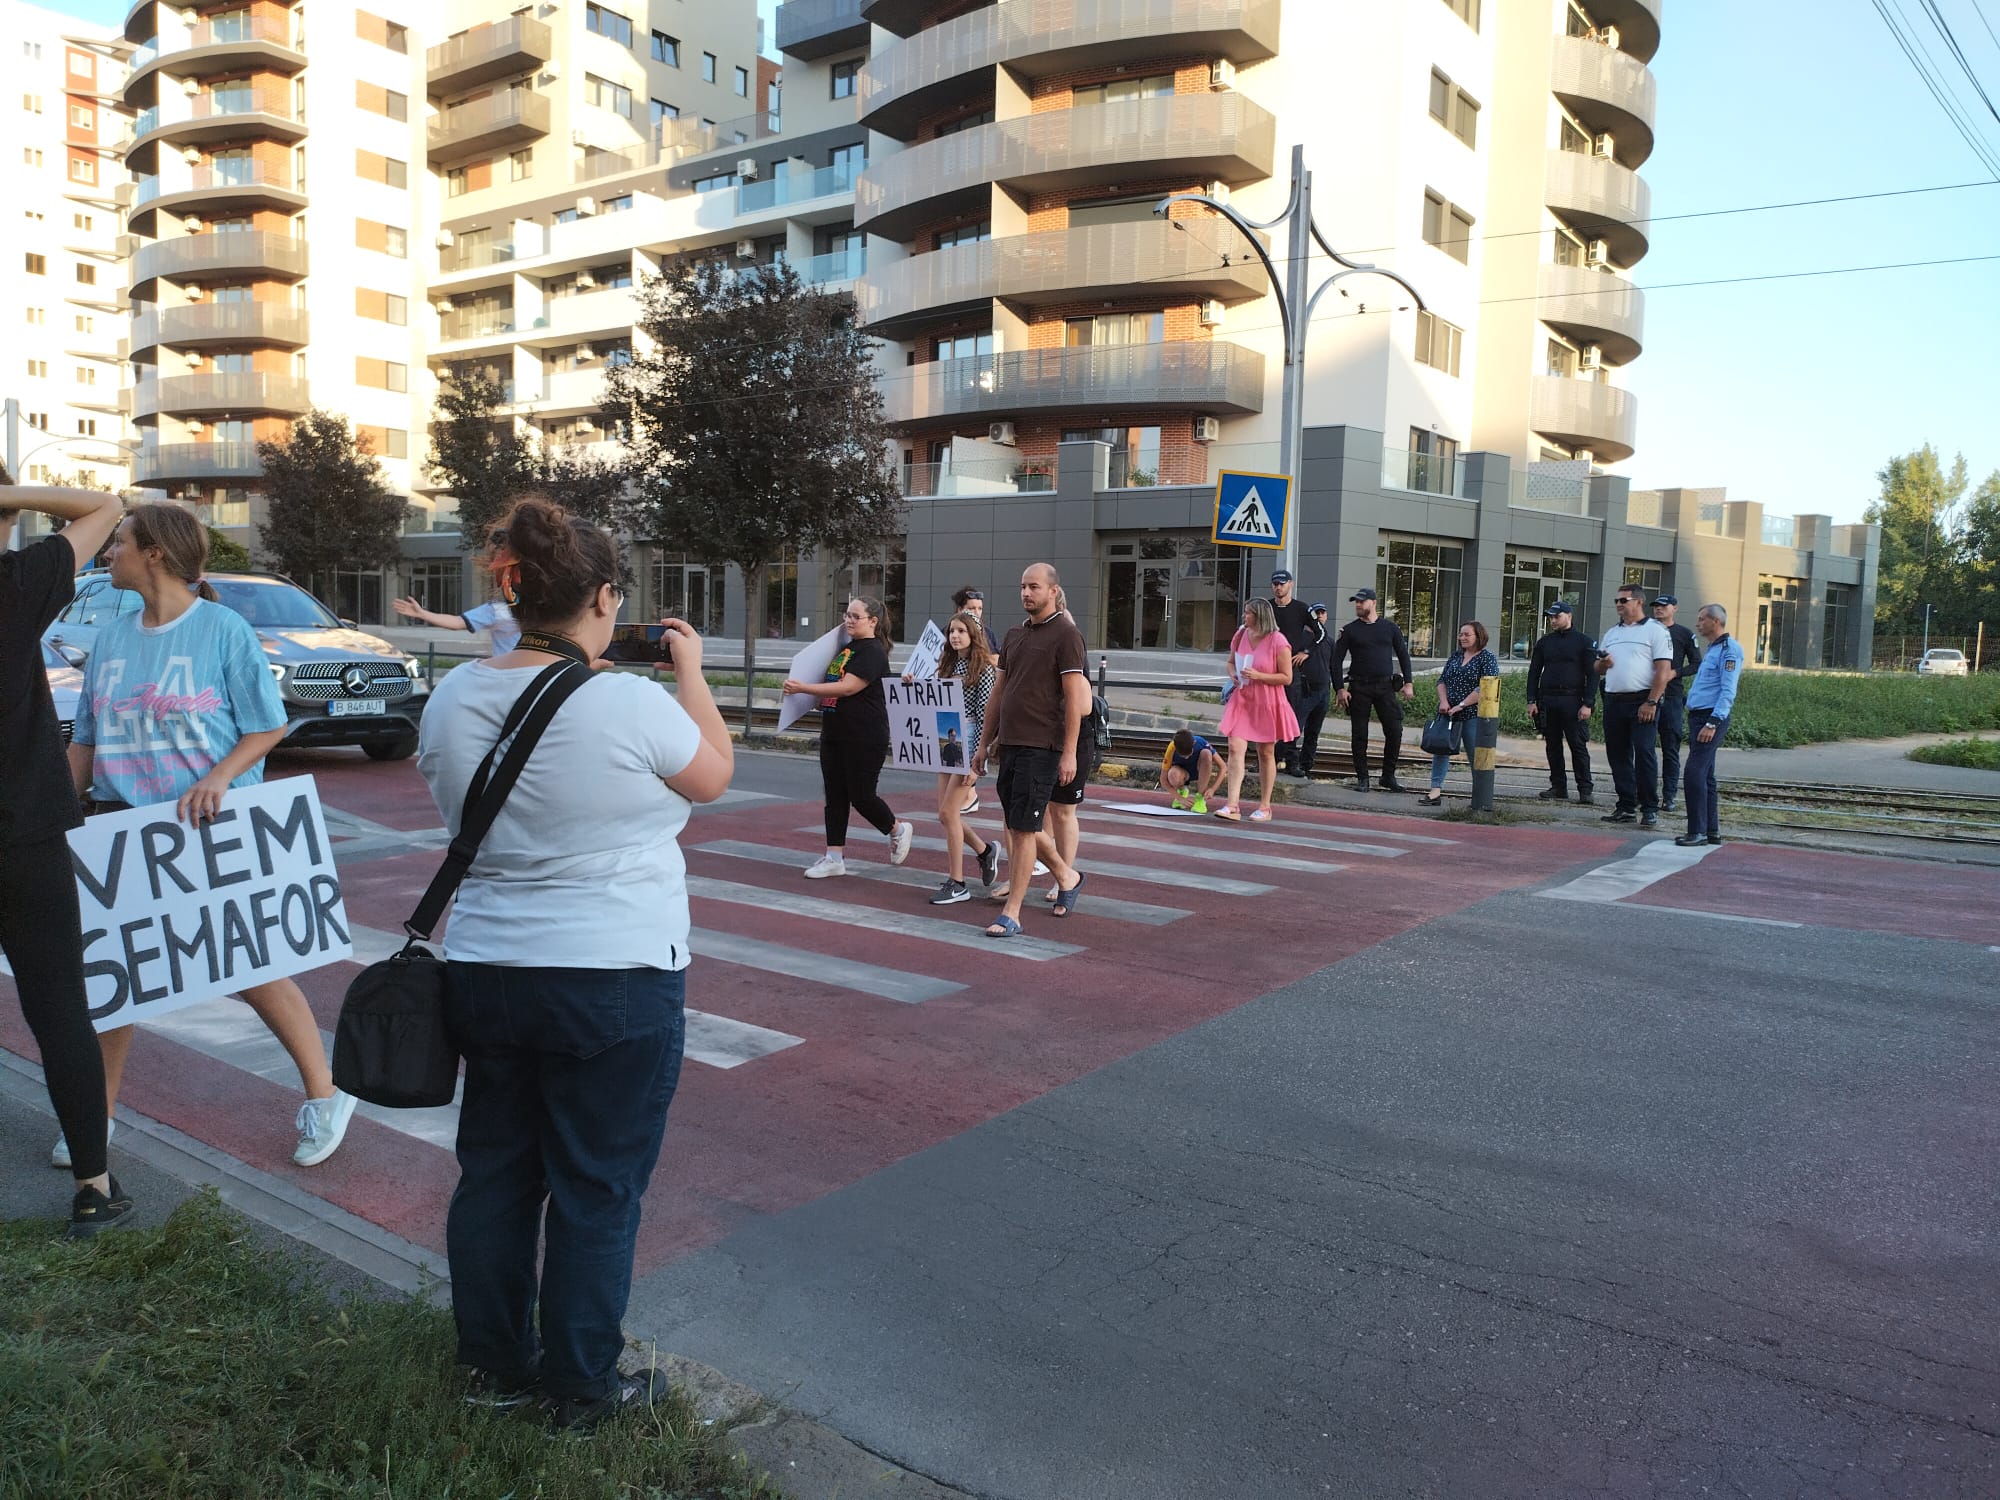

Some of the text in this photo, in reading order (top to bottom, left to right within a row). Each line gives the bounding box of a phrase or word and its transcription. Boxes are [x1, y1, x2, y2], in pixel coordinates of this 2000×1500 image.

[521, 635, 550, 648] Nikon
[889, 684, 900, 704] A
[336, 702, 343, 712] B
[906, 717, 923, 738] 12
[69, 794, 323, 910] VREM
[82, 874, 352, 1022] SEMAFOR
